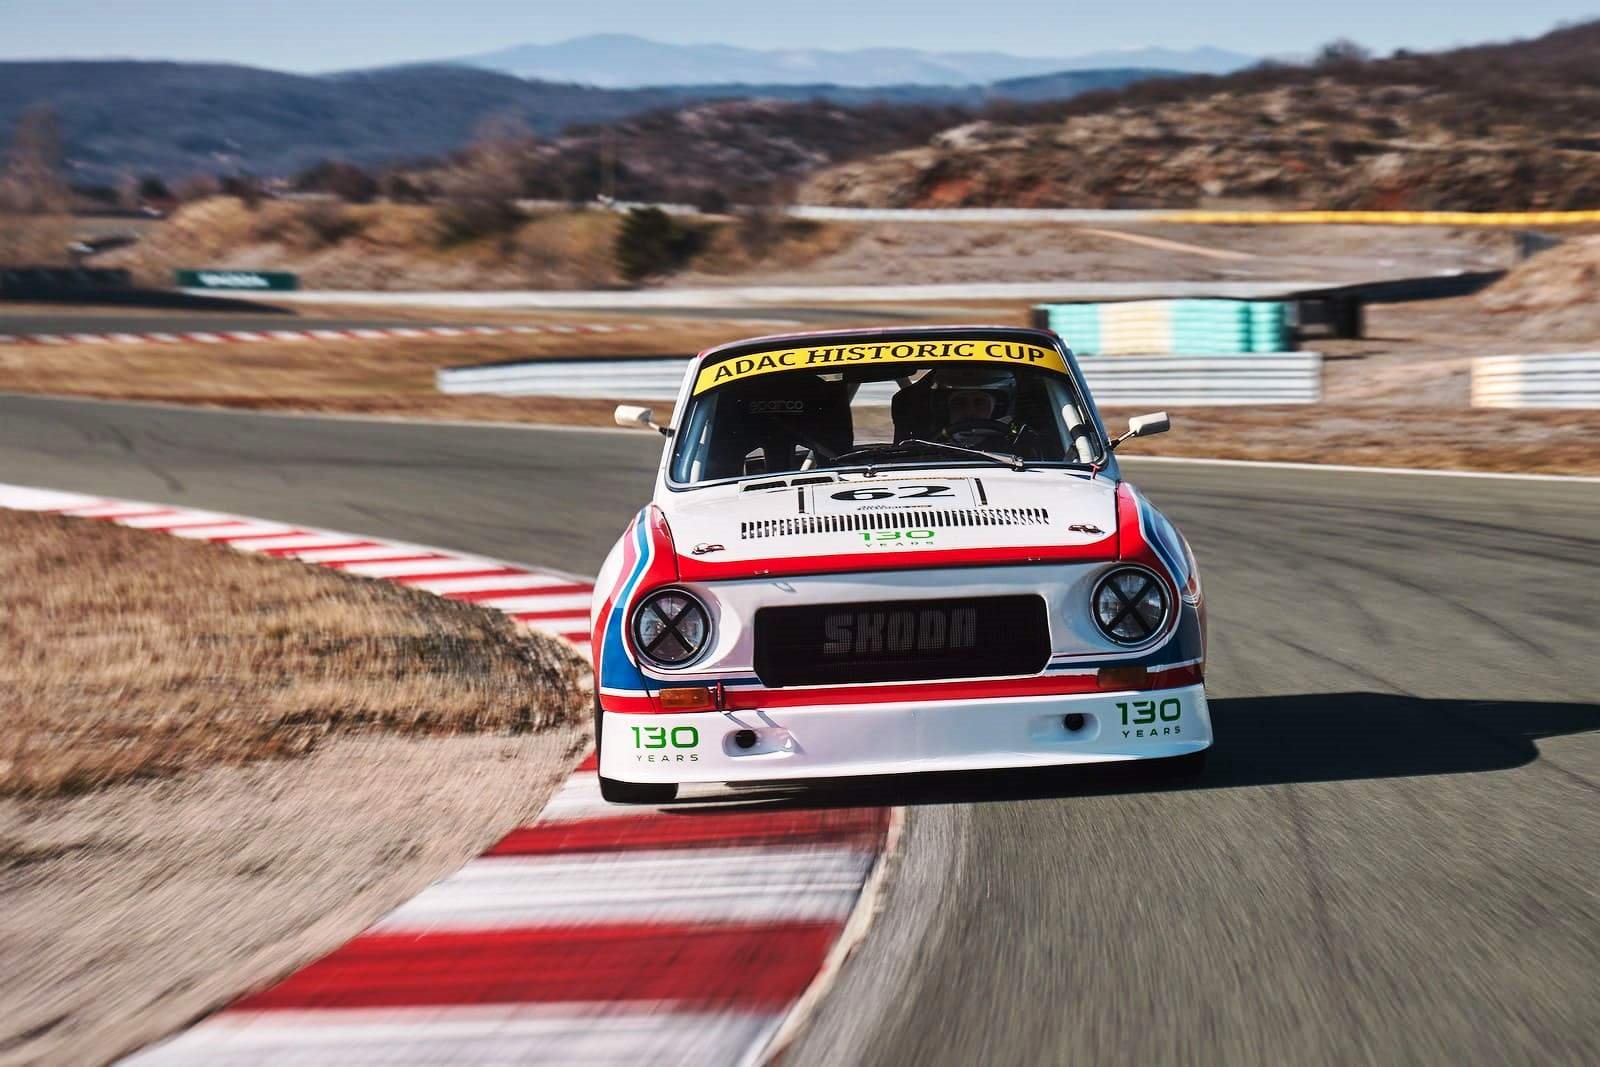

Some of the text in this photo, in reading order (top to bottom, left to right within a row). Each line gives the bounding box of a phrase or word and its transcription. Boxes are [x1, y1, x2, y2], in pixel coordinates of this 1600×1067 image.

[713, 343, 1045, 382] ADAC HISTORIC CUP
[830, 485, 955, 501] 62
[859, 529, 935, 542] 130
[1116, 698, 1181, 725] 130
[631, 726, 699, 749] 130
[1122, 726, 1181, 738] YEARS
[636, 753, 699, 762] YEARS
